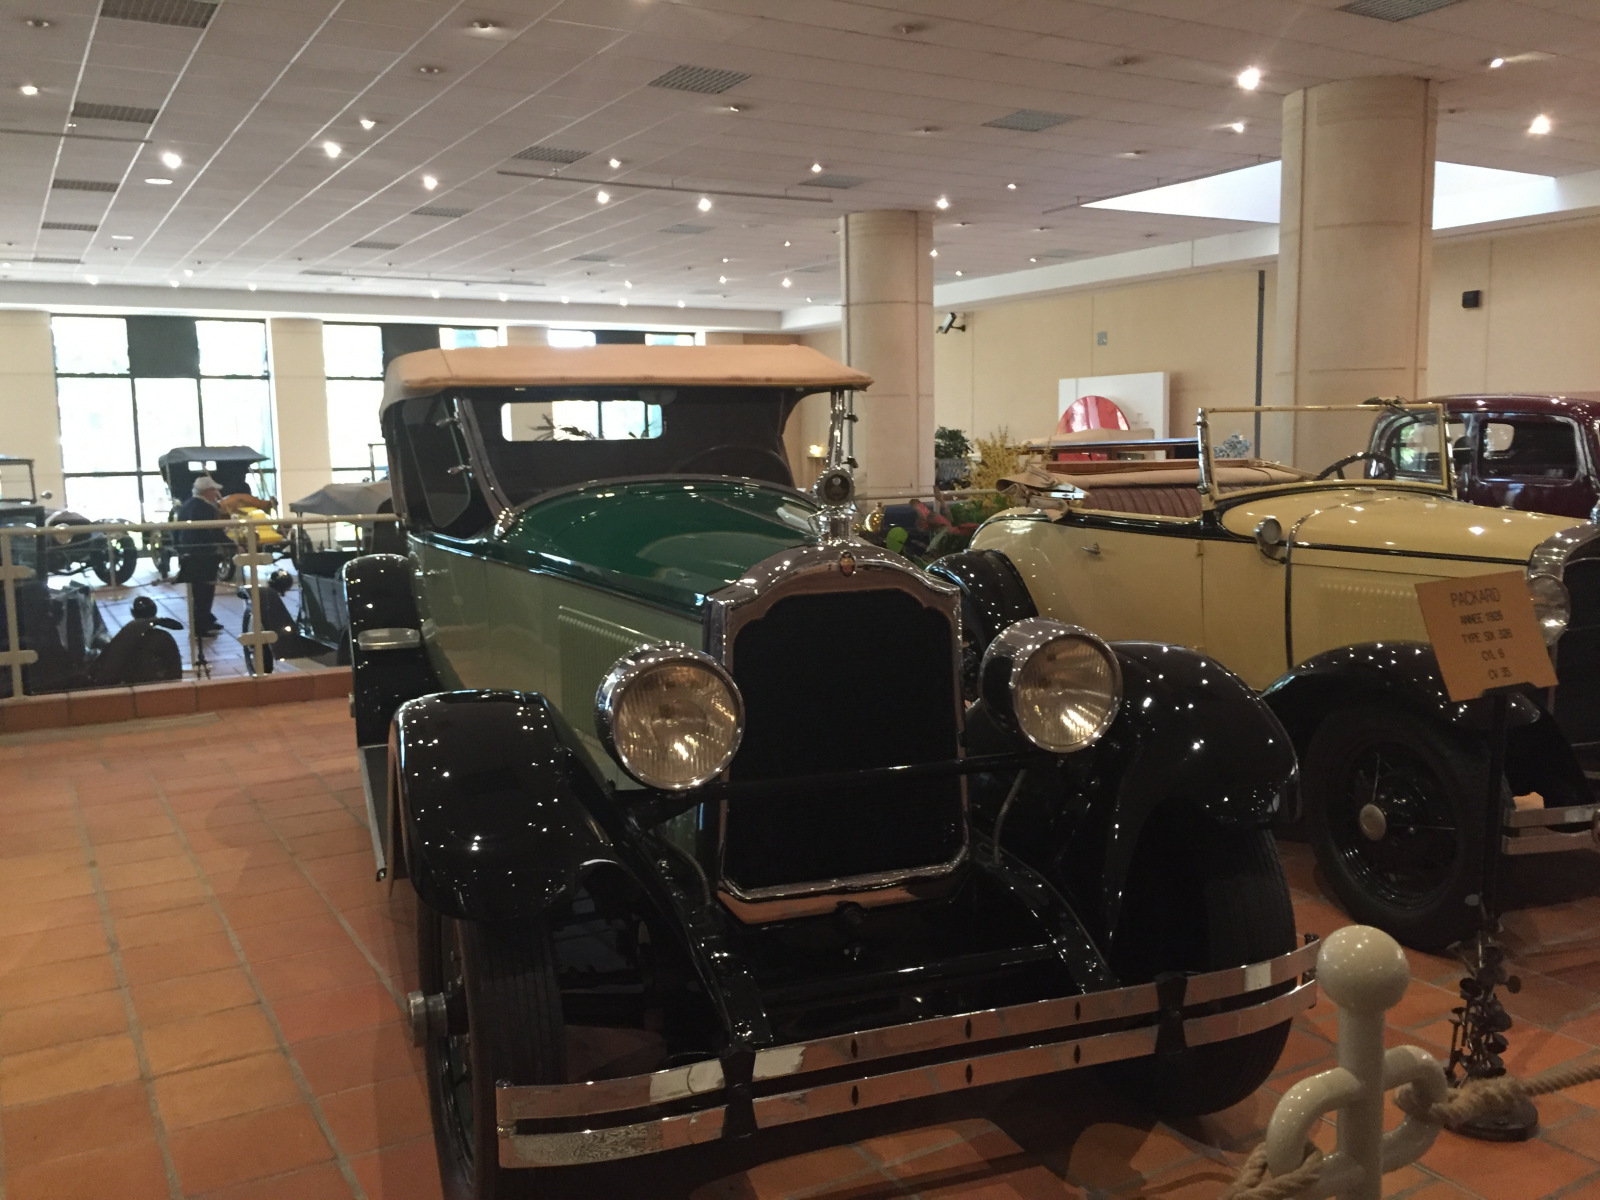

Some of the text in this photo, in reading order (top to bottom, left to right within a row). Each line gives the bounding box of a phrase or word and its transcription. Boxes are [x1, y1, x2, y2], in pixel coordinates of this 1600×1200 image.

[1450, 587, 1500, 608] PACKARD
[1461, 631, 1483, 644] TYPE
[1484, 630, 1496, 642] SIX
[1481, 649, 1496, 661] CYL
[1488, 668, 1498, 680] CV
